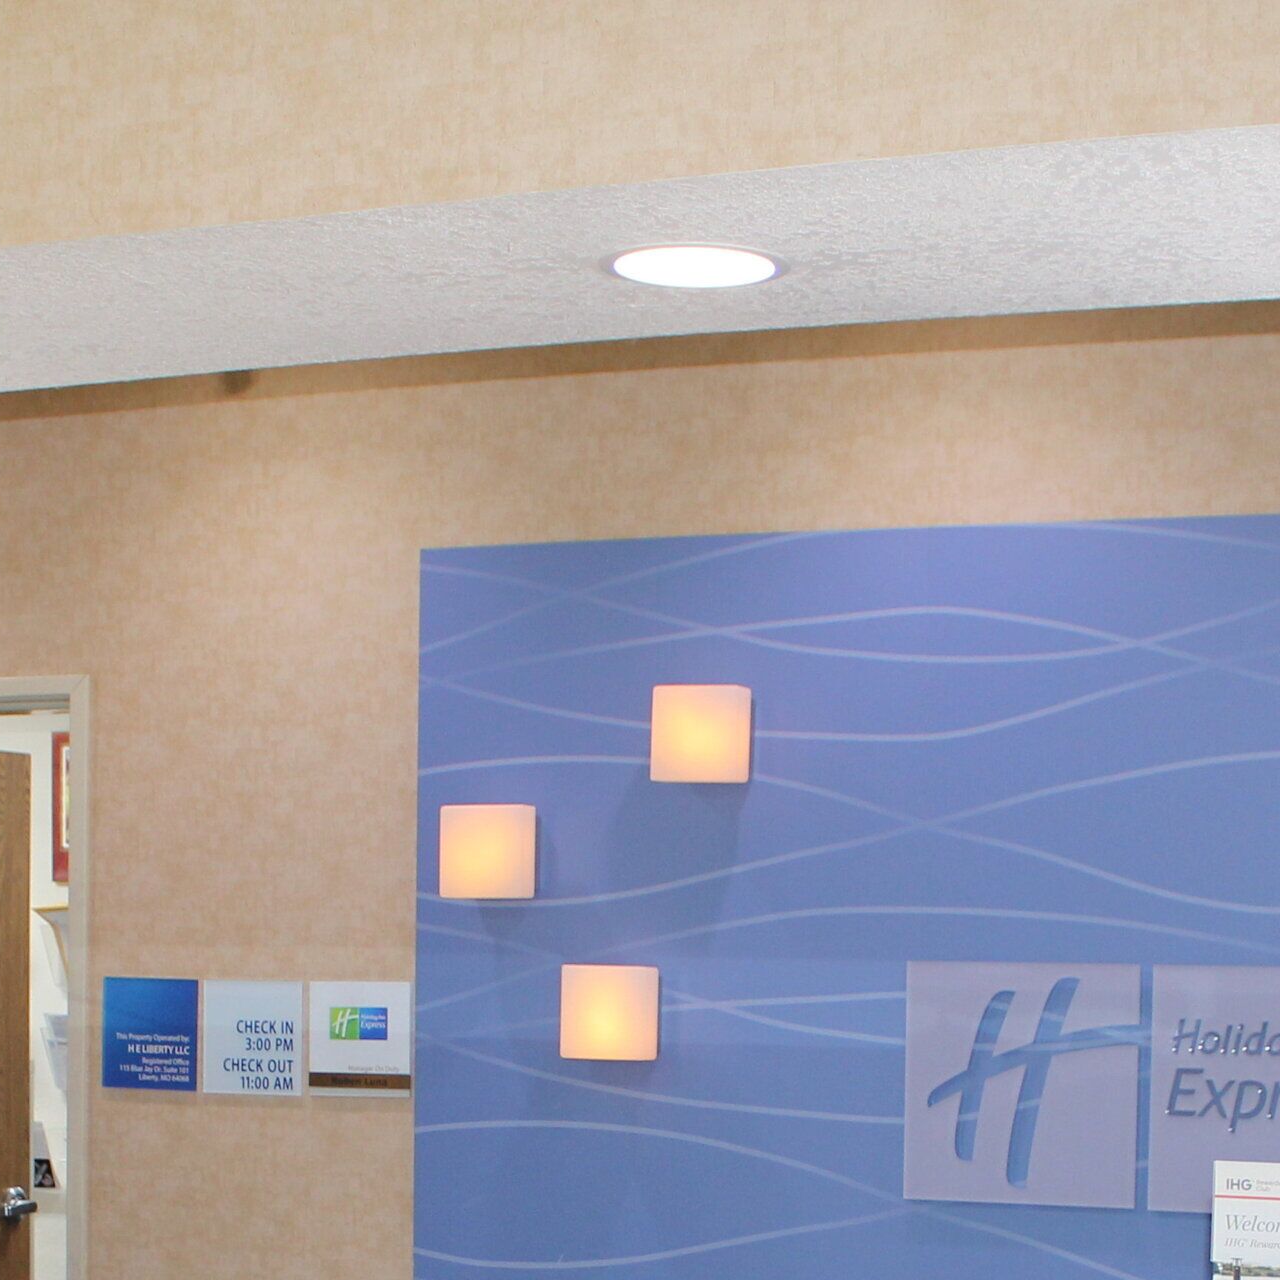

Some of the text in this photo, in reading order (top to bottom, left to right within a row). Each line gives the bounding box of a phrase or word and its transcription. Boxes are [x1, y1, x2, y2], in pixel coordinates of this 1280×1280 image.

[236, 1020, 294, 1034] CHECK IN
[360, 1020, 386, 1030] Express
[128, 1044, 190, 1055] H E LIBERTY LLC
[245, 1037, 294, 1052] 3:00 PM
[223, 1058, 294, 1073] CHECK OUT
[240, 1076, 293, 1090] 11:00 AM
[1226, 1178, 1252, 1191] IHG
